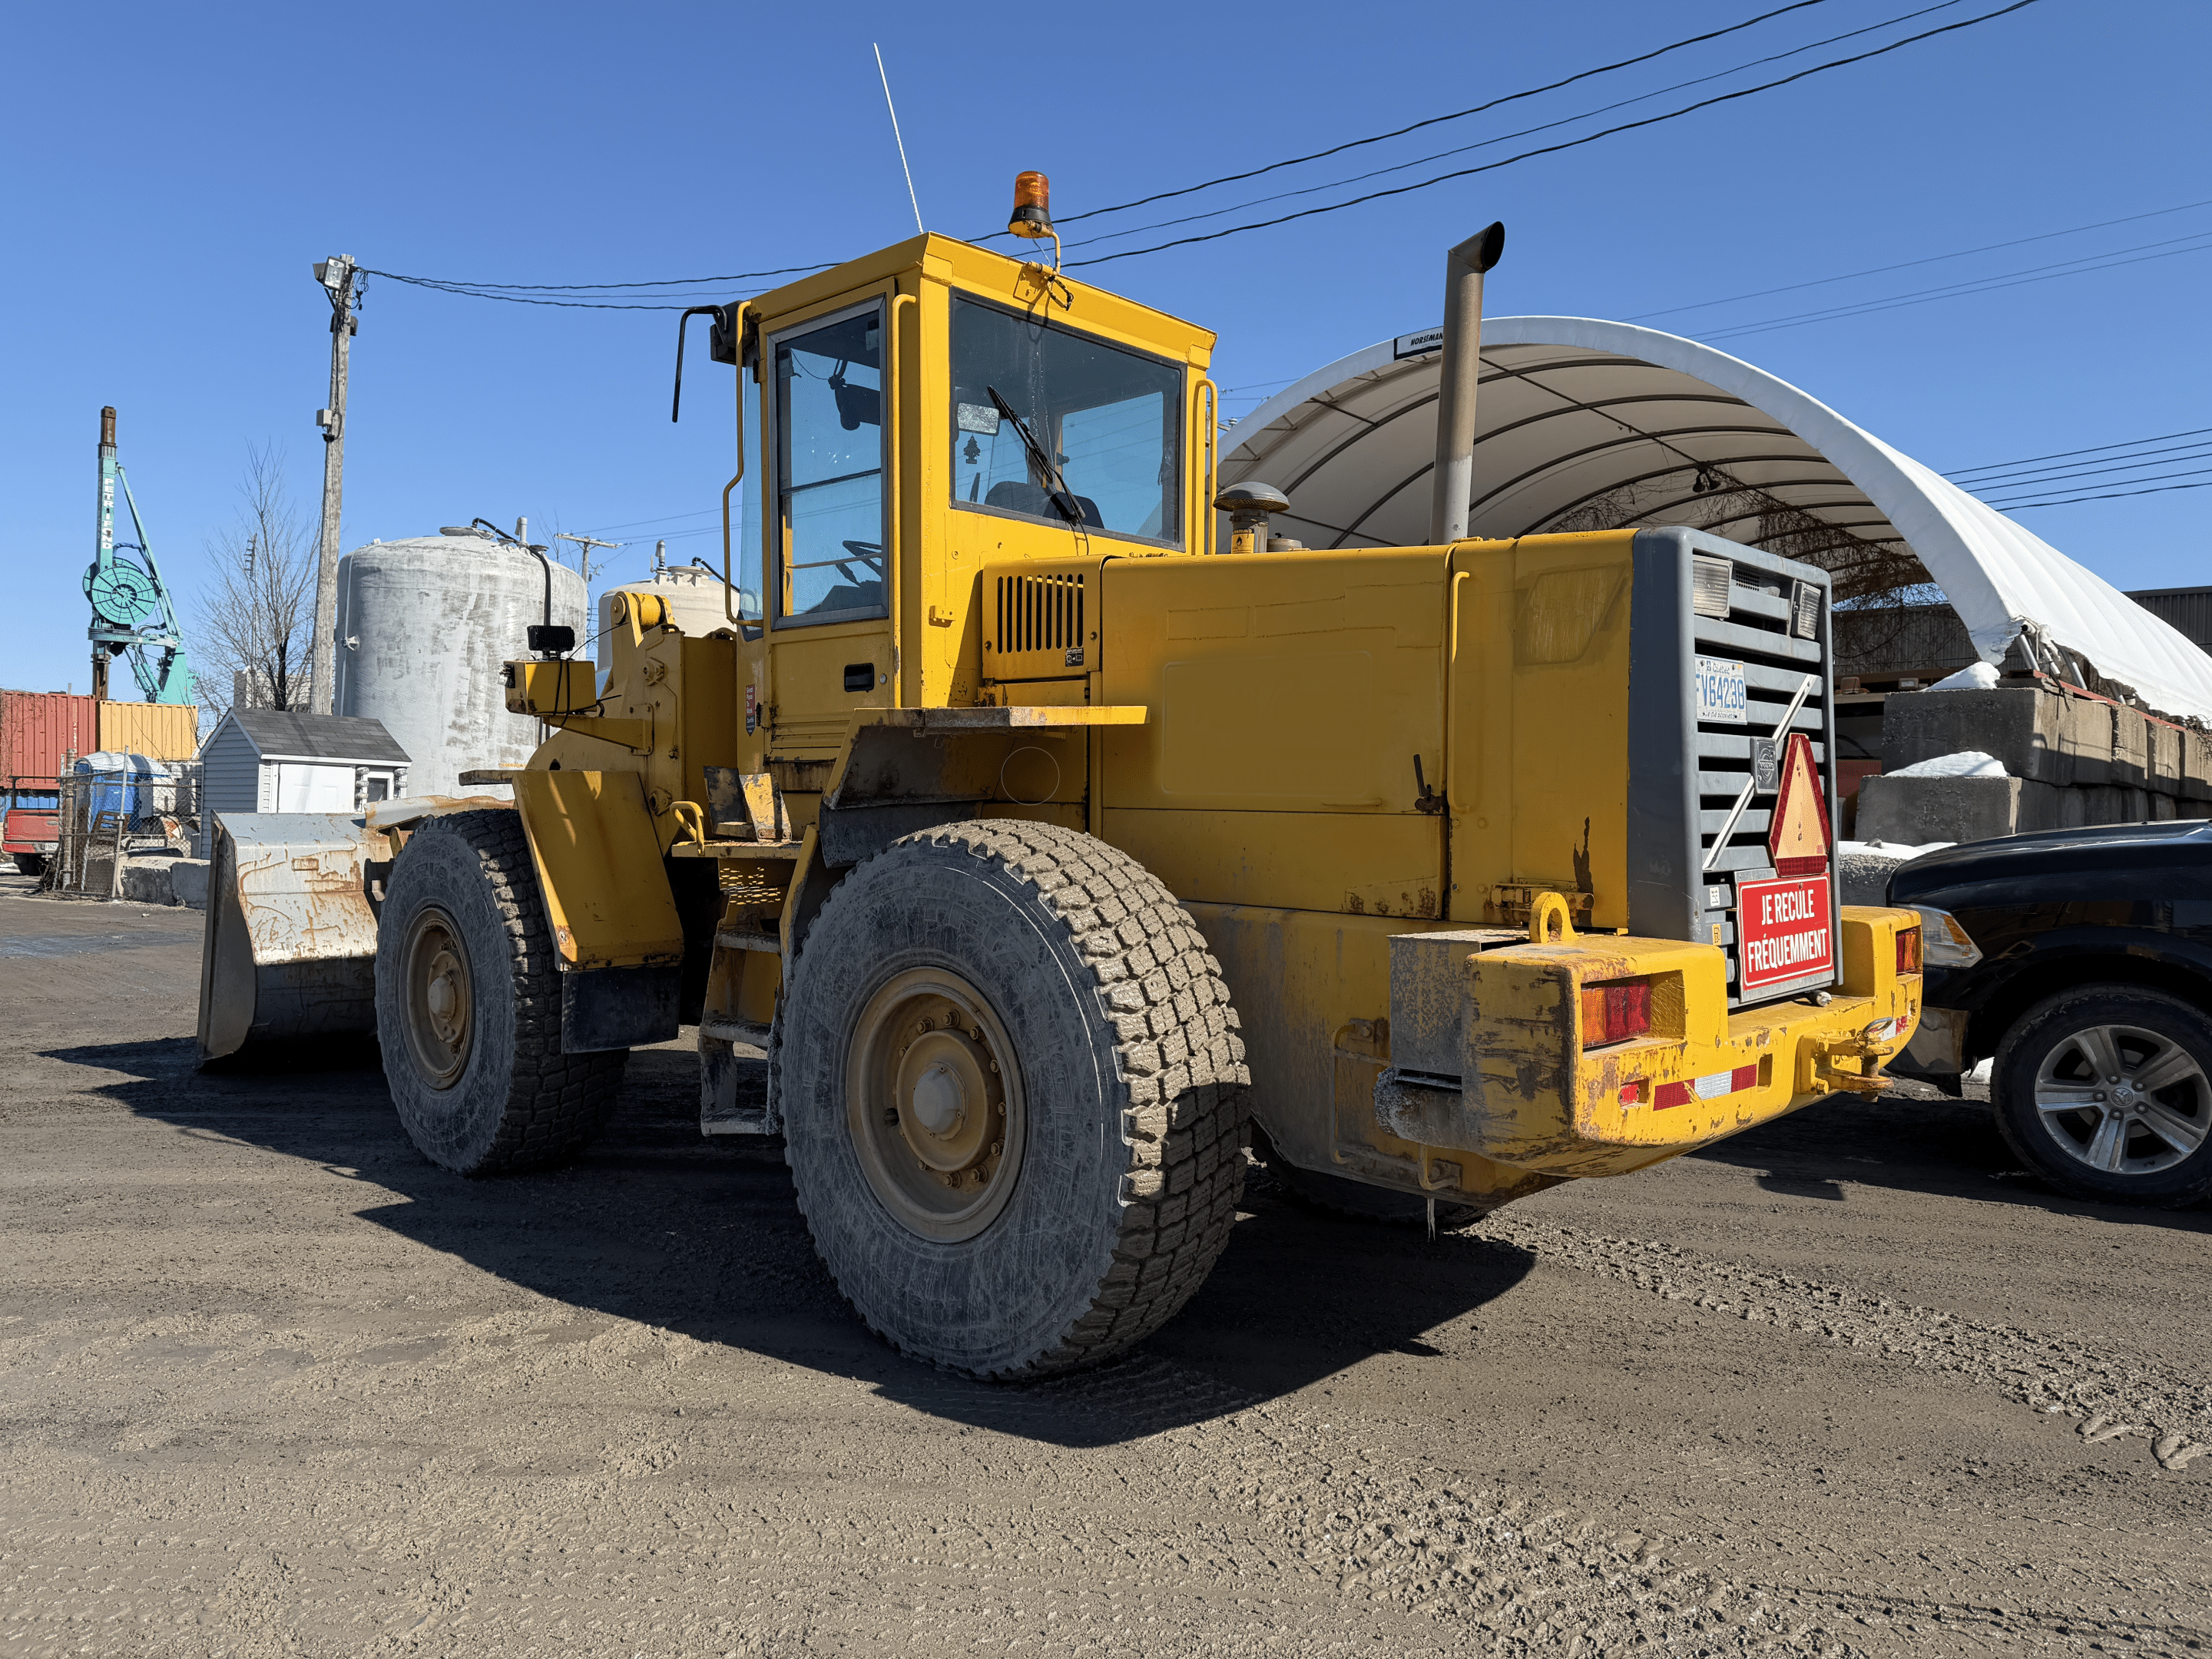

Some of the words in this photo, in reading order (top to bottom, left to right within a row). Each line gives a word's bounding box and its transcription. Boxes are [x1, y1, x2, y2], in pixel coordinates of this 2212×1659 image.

[1410, 333, 1443, 346] NORSEMAN
[101, 478, 114, 549] PETRIFOND
[1761, 894, 1773, 926] JE
[1775, 889, 1815, 923] RECULE
[1747, 927, 1828, 973] FRÉQUEMMENT
